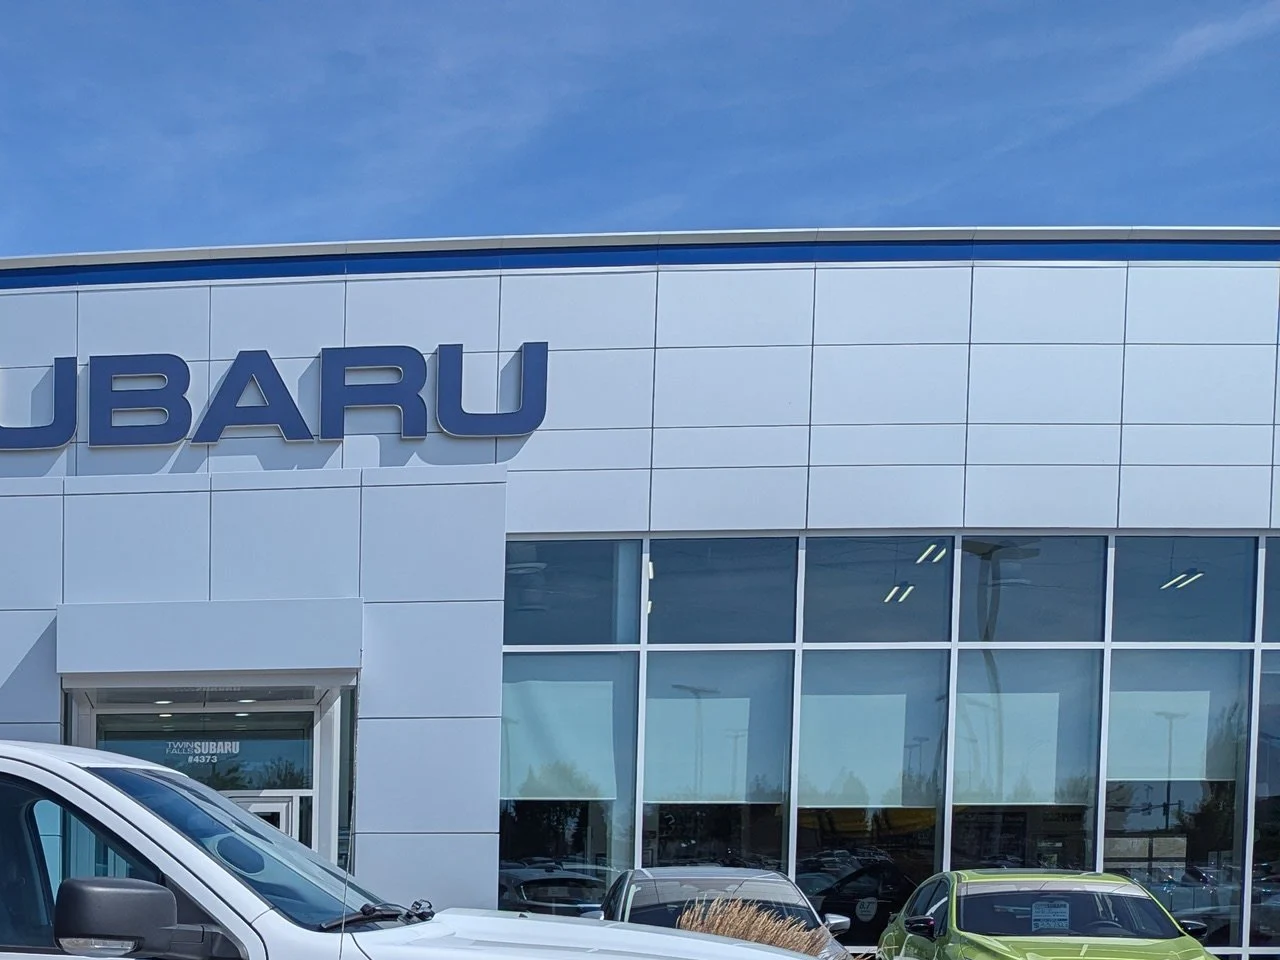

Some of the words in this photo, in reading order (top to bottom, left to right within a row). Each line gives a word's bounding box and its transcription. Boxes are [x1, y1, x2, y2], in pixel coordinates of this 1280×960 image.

[166, 741, 194, 749] TWIN
[194, 741, 240, 755] SUBARU
[166, 747, 194, 755] FALLS
[188, 755, 218, 763] #4373
